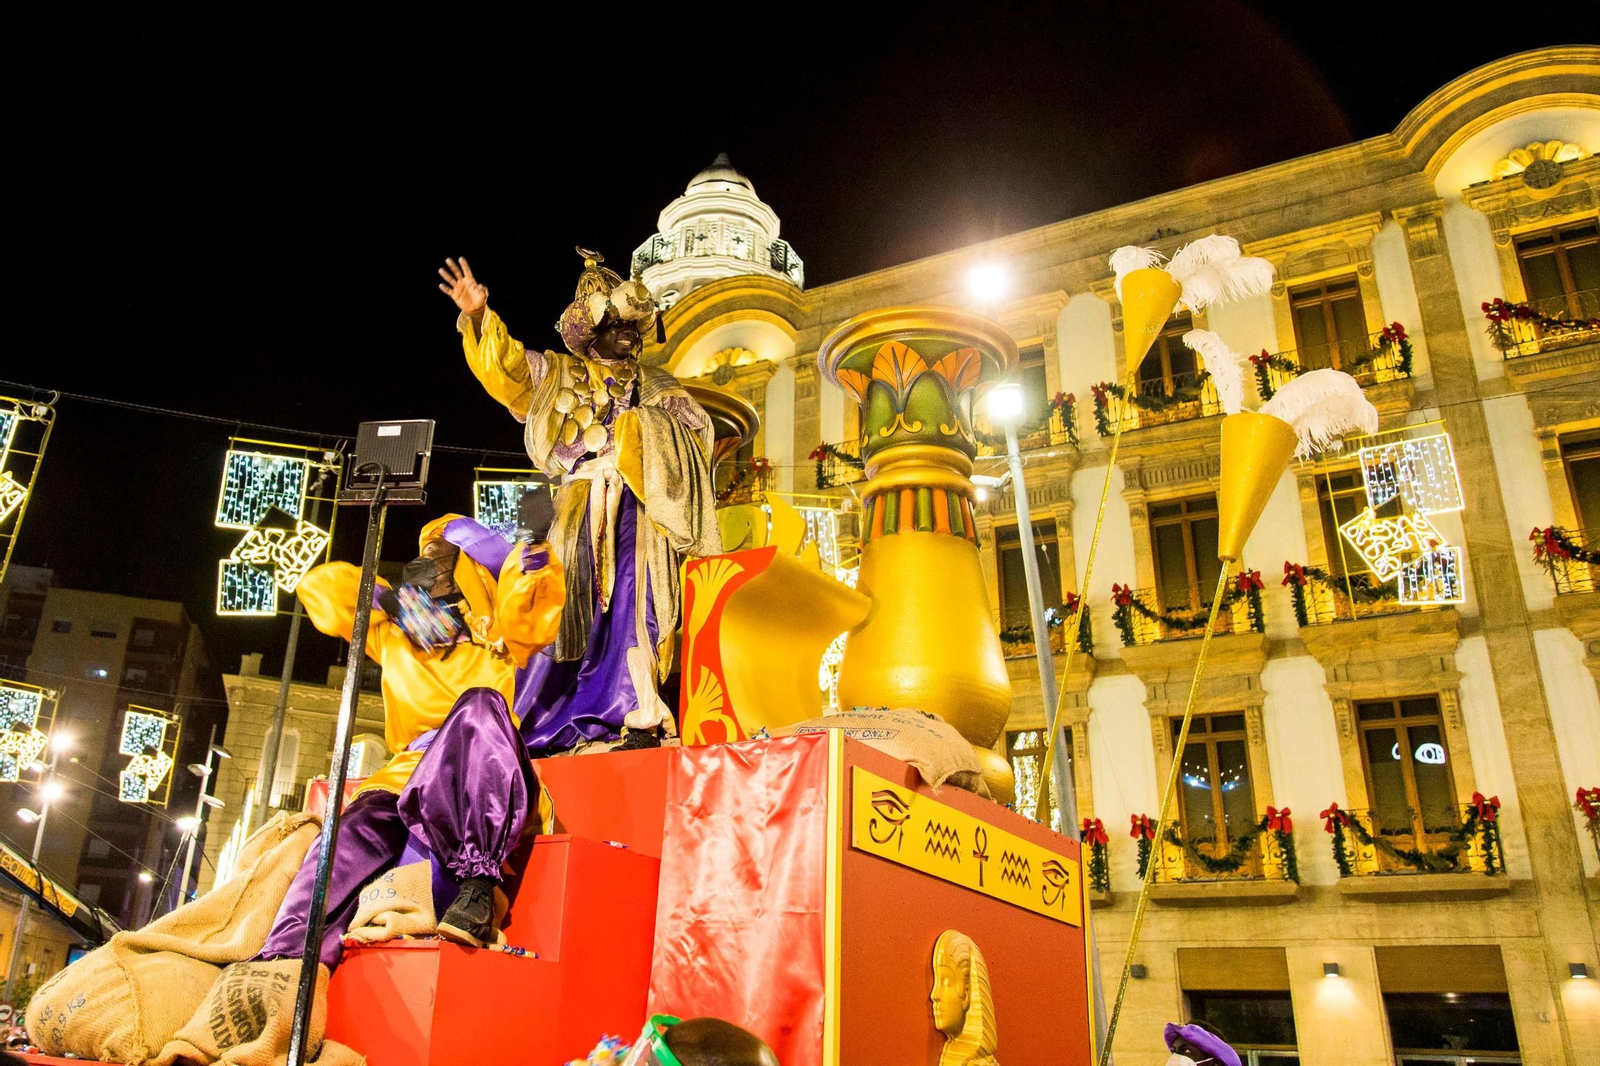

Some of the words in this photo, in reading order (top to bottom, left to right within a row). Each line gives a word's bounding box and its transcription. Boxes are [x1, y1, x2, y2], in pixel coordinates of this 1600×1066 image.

[861, 729, 893, 739] ONLY
[361, 888, 397, 905] 60.9
[66, 993, 87, 1013] KG
